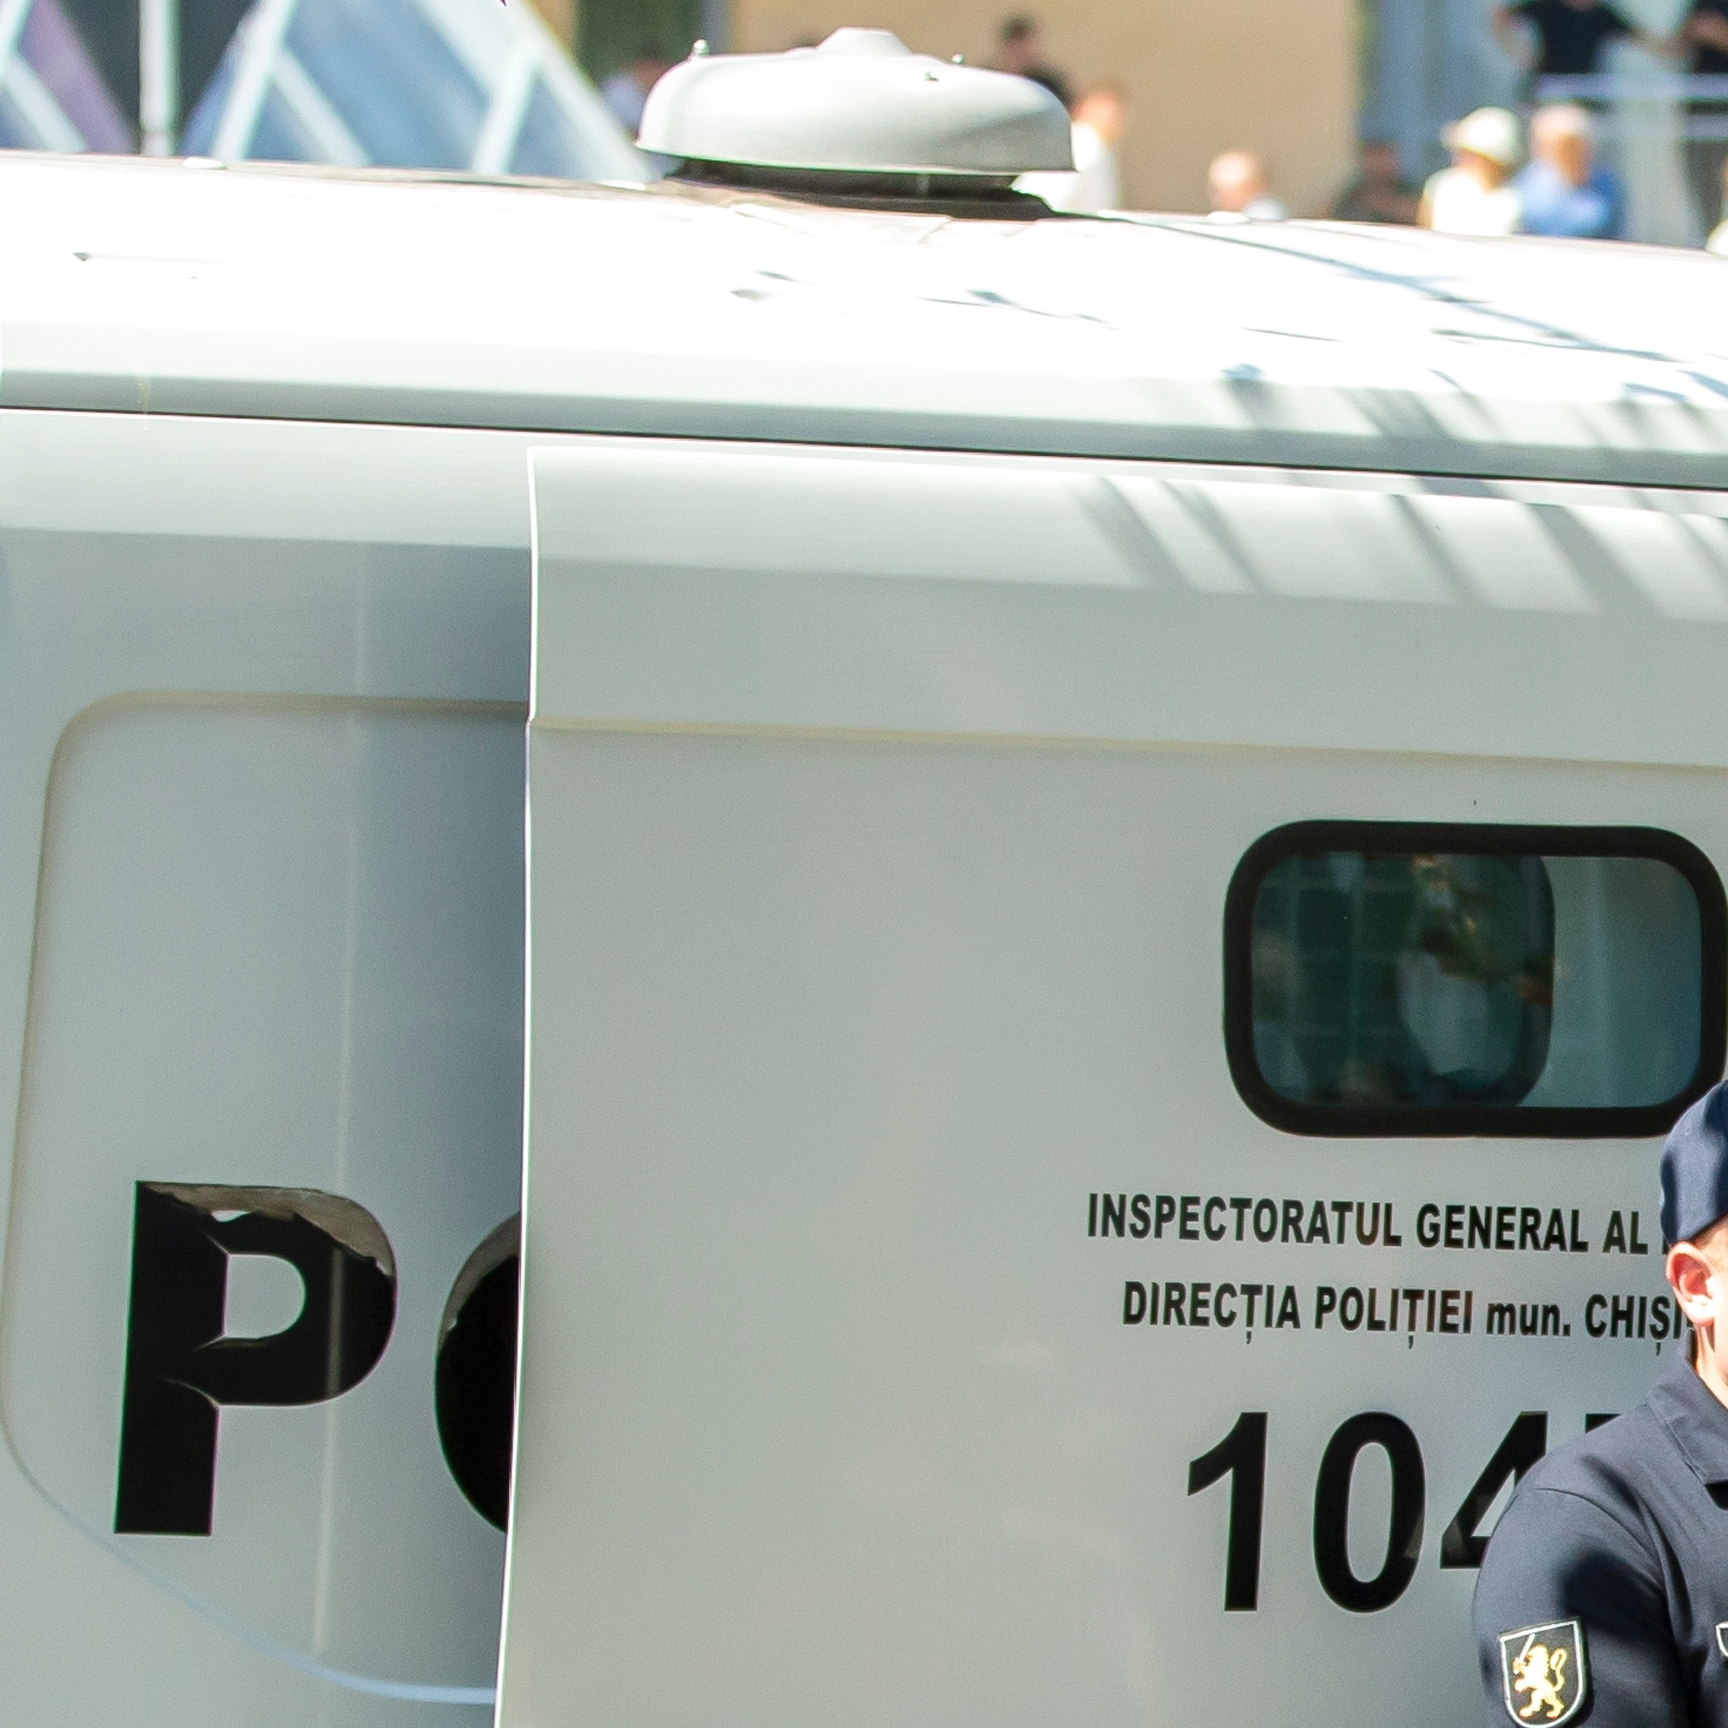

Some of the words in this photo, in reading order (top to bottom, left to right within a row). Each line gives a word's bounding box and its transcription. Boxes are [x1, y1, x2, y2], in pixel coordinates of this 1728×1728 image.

[1087, 1192, 1402, 1247] INSPECTORATUL
[1417, 1203, 1589, 1254] GENERAL
[1602, 1210, 1649, 1256] AL
[1122, 1281, 1301, 1345] DIRECȚIA
[1314, 1287, 1474, 1349] POLIȚIEI
[1486, 1301, 1571, 1337] mun.
[1585, 1293, 1693, 1356] CHIȘI
[1187, 1411, 1622, 1613] 104
